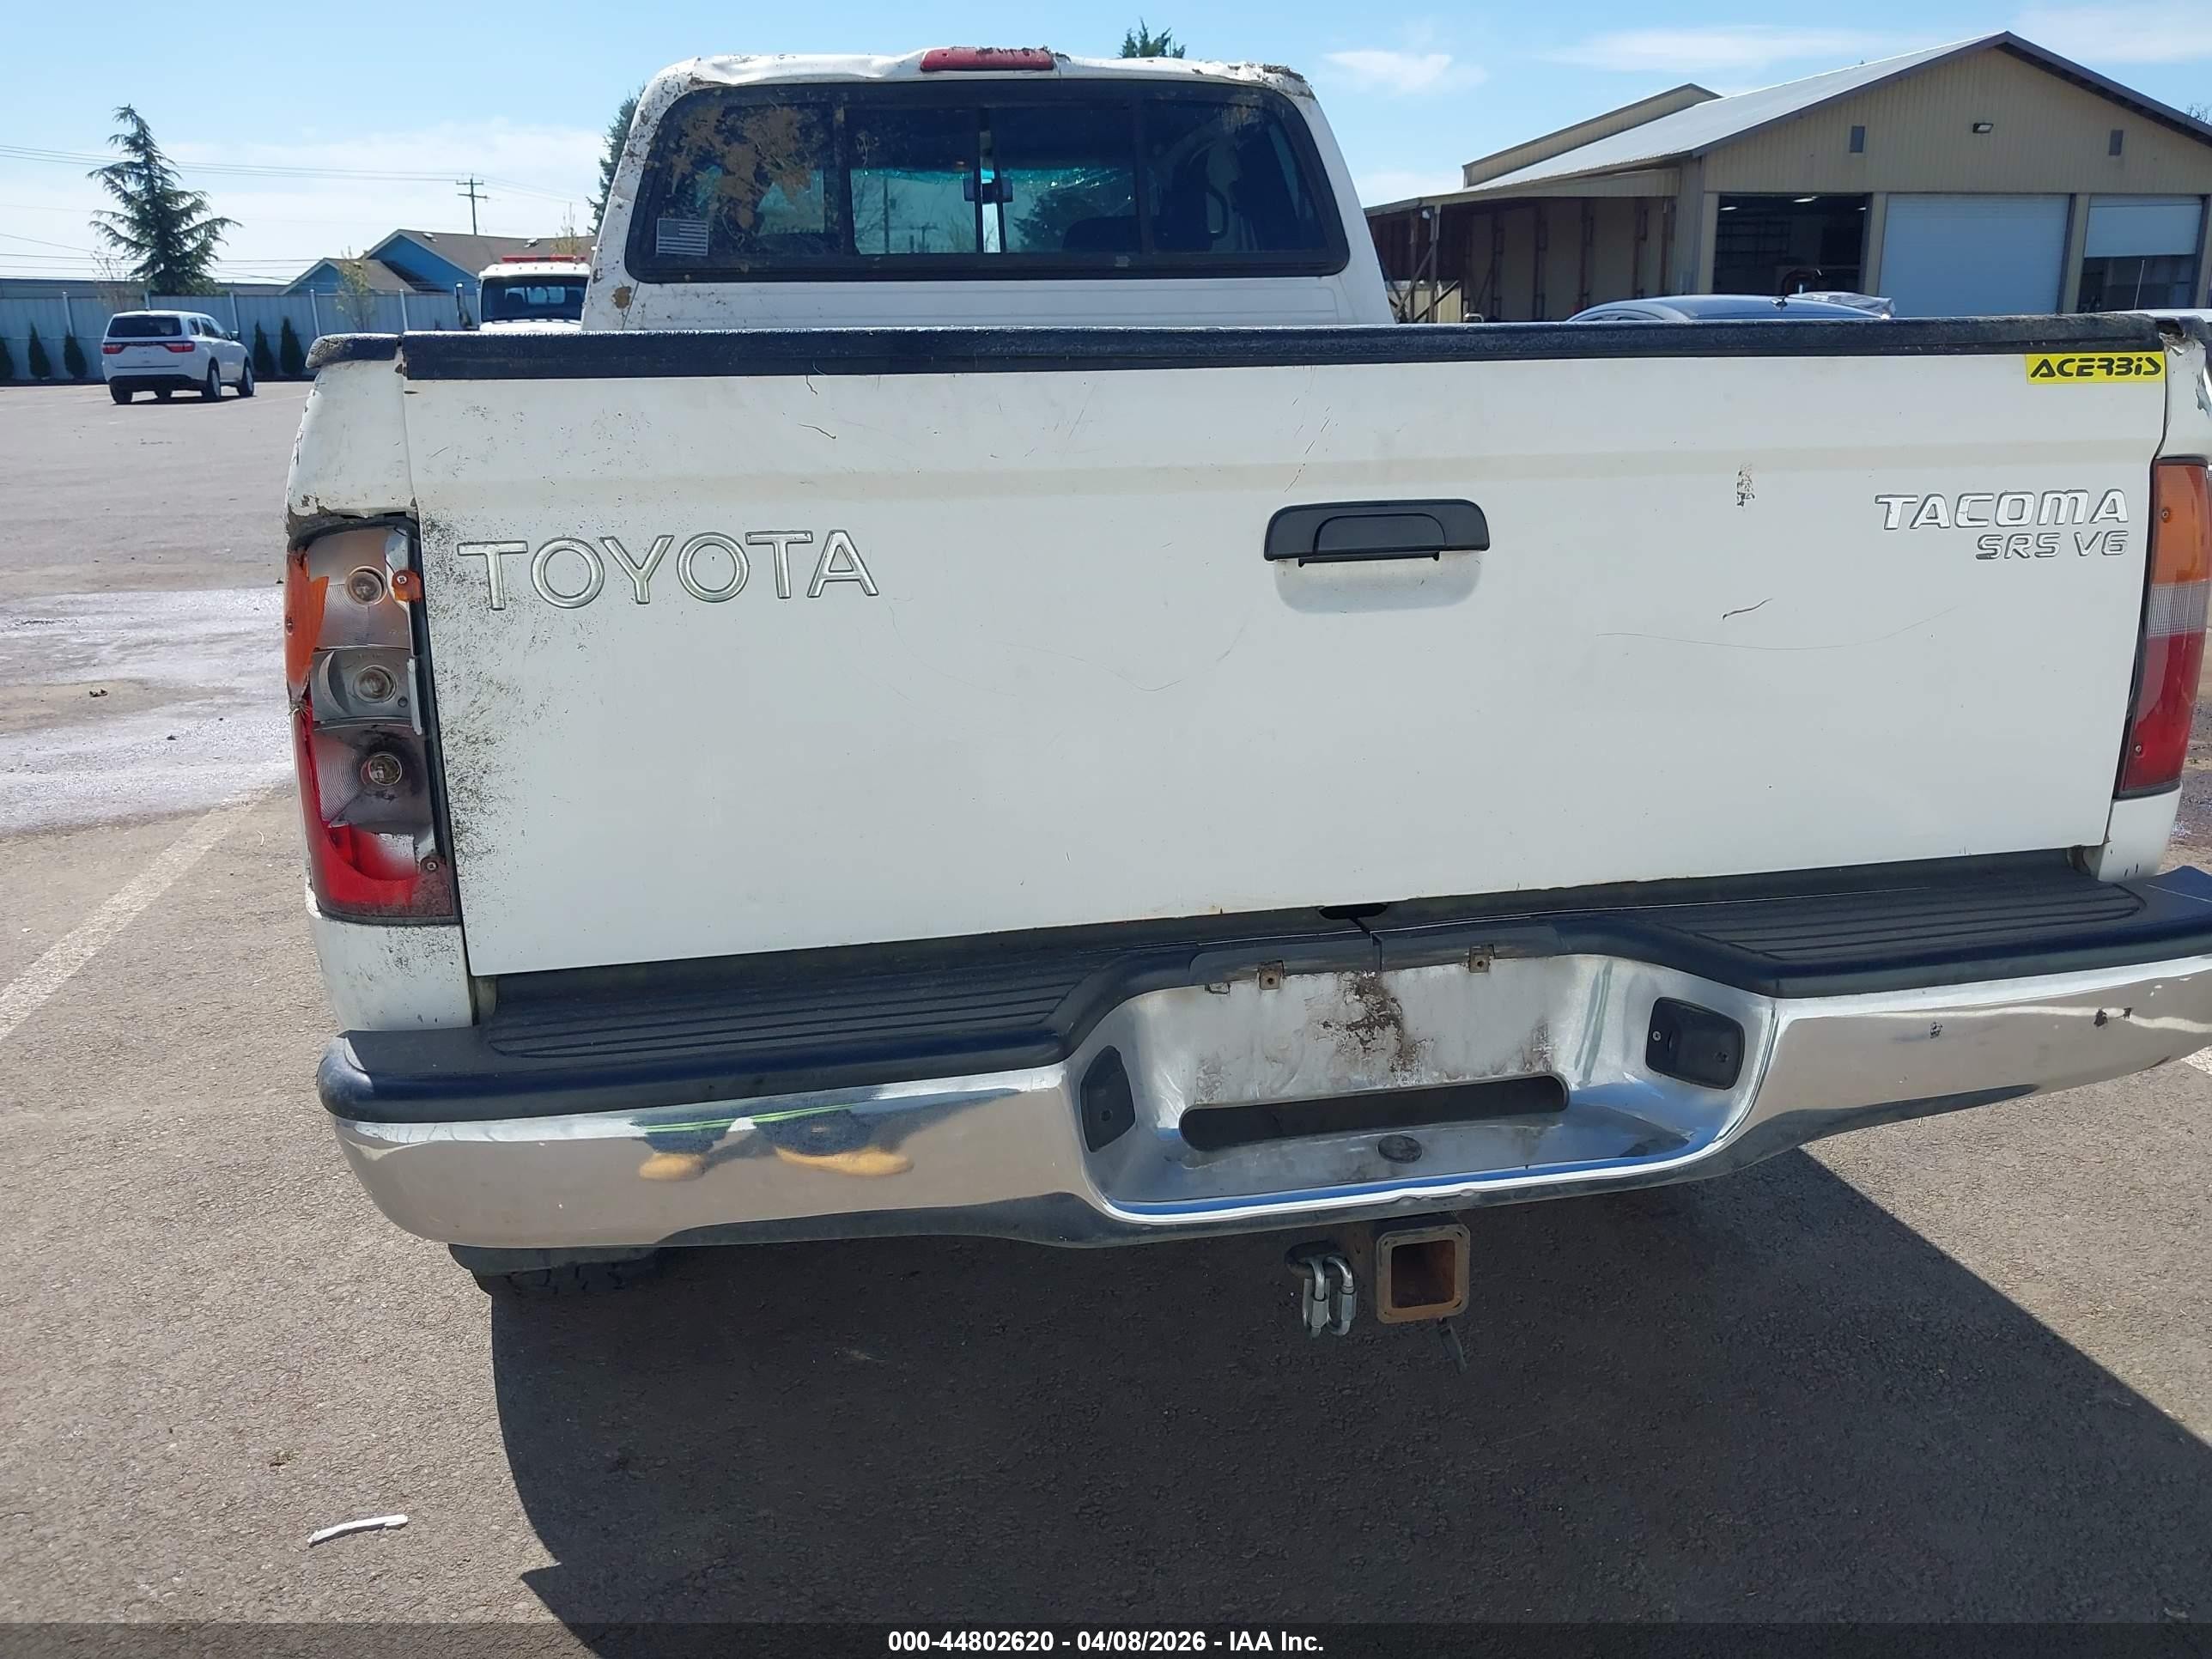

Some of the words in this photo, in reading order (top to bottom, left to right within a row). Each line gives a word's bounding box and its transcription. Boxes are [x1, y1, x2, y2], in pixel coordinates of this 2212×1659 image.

[1875, 489, 2129, 530] TACOMA
[1976, 532, 2061, 560] SR5
[2074, 531, 2129, 557] V6
[457, 530, 879, 611] TOYOTA
